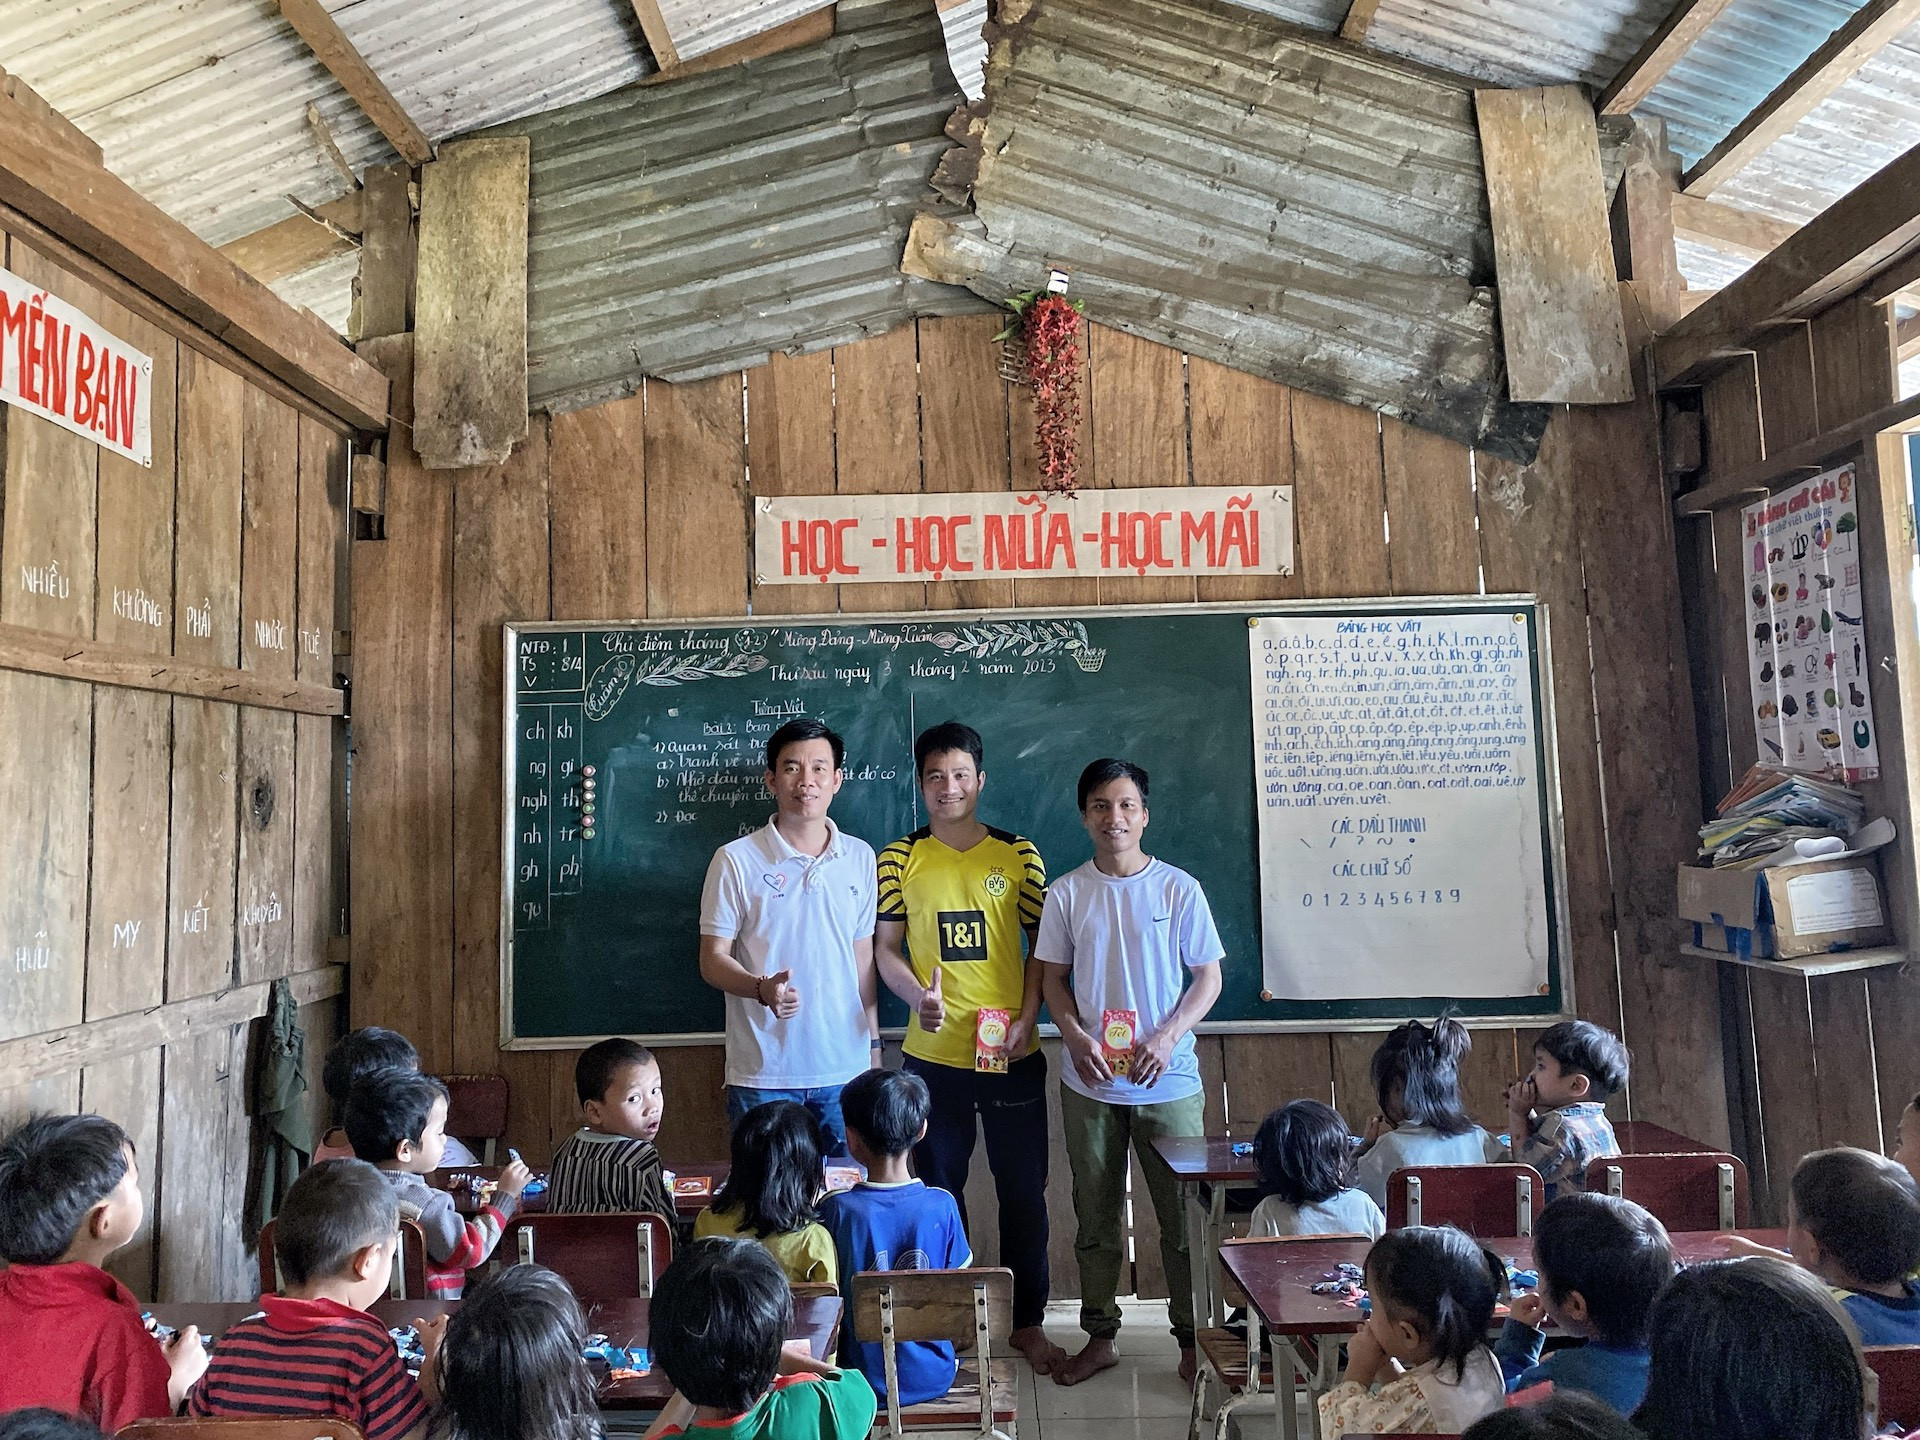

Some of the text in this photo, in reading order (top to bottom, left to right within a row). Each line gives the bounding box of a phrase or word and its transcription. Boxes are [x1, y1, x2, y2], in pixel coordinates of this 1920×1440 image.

[74, 332, 136, 449] BẠN
[781, 518, 859, 583] HỌC
[897, 514, 974, 580] HỌC
[983, 493, 1076, 571] NỮA
[1100, 511, 1173, 576] HỌC
[1181, 492, 1260, 567] MÃI
[21, 559, 69, 599] NHIỀU
[186, 597, 212, 638] PHẢI
[1337, 620, 1368, 633] BẢNG
[1372, 622, 1392, 635] HỌC
[302, 627, 321, 660] TUỆ
[680, 630, 729, 656] tháng
[520, 656, 536, 671] TS
[835, 662, 870, 686] ngày
[883, 661, 892, 676] 3
[910, 657, 955, 680] tháng
[961, 660, 969, 673] 2
[978, 658, 1014, 675] năm
[1023, 658, 1056, 675] 2023
[751, 698, 781, 720] Tiếng
[526, 721, 545, 740] ch
[529, 759, 574, 779] ng gi
[858, 765, 879, 780] đó
[881, 765, 896, 780] có
[522, 787, 579, 814] ngh th
[674, 810, 698, 824] Đọc
[1332, 816, 1354, 833] CÁC
[1389, 817, 1426, 833] THANH
[523, 823, 576, 844] nh tr
[520, 855, 580, 883] gh ph
[1333, 860, 1358, 877] CÁC
[1395, 854, 1413, 875] SỐ
[989, 876, 1004, 889] BVB
[1303, 889, 1460, 907] 0 1 2 3 4 5 6 7 8 9
[183, 890, 210, 934] KIẾT
[113, 920, 142, 948] MY
[942, 922, 981, 948] 1&1
[16, 930, 50, 973] HỮU
